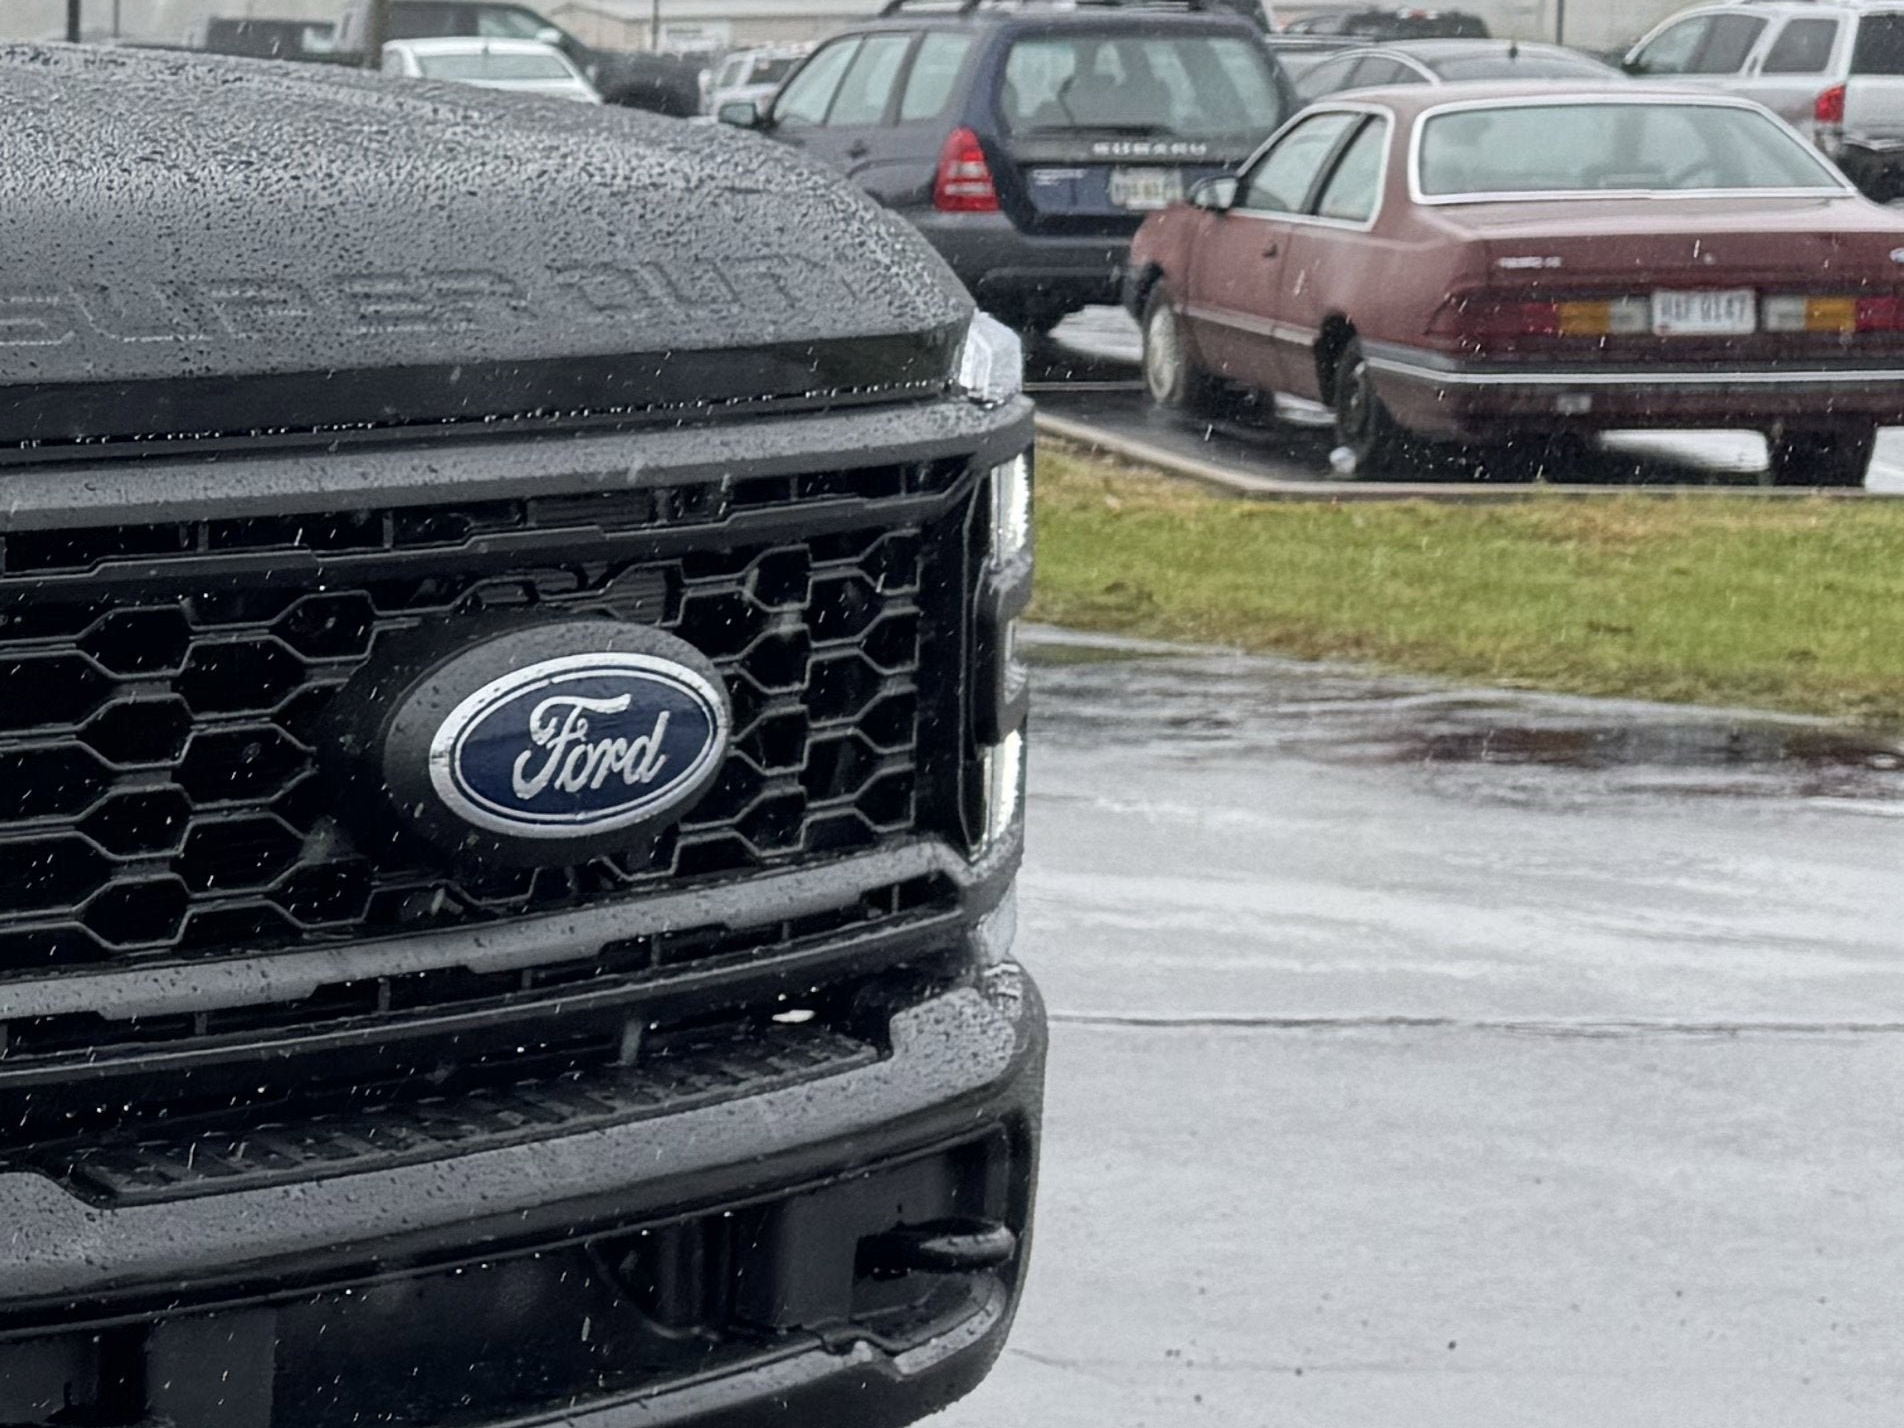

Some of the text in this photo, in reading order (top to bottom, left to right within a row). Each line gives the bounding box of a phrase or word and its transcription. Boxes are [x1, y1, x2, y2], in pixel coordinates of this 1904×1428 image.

[1093, 141, 1207, 157] SUBARU
[545, 252, 860, 322] DUTY
[512, 692, 671, 801] Ford
